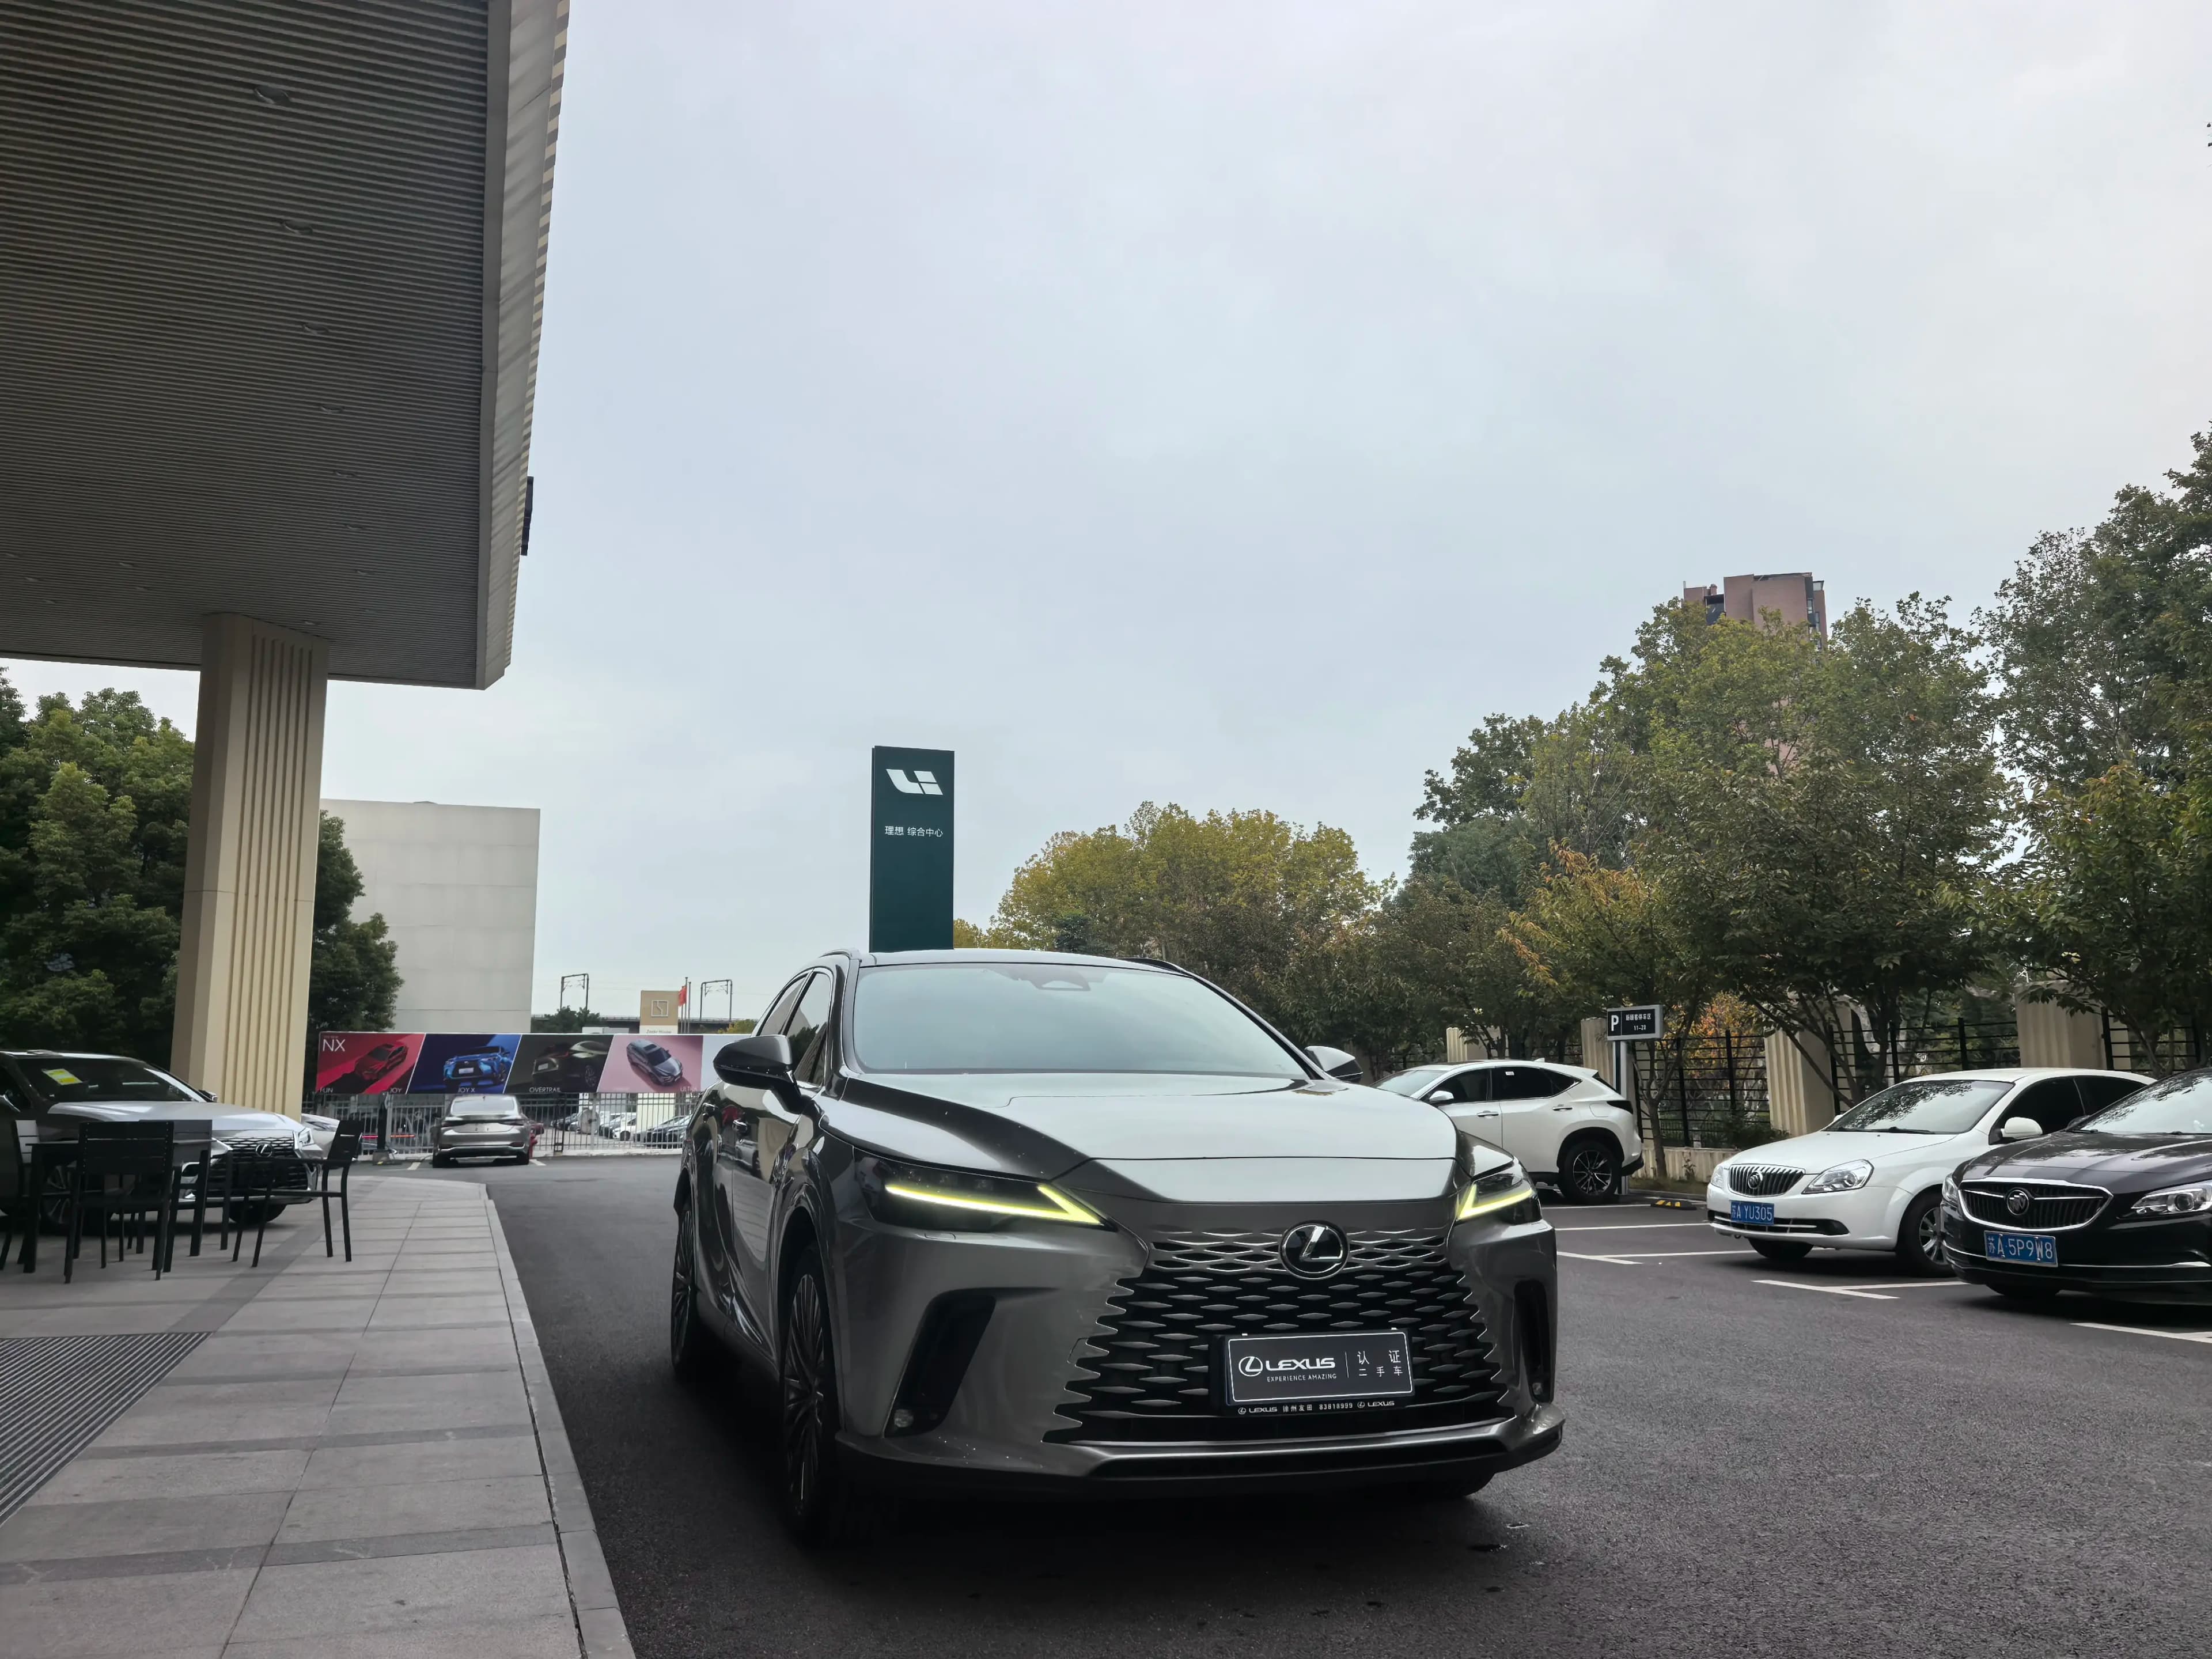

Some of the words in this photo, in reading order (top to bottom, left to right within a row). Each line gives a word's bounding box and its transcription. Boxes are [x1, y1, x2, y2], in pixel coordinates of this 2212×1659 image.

[885, 825, 904, 835] 理想
[907, 827, 943, 837] 综合中心
[1611, 1015, 1619, 1031] P
[323, 1039, 346, 1052] NX
[1266, 1357, 1336, 1371] LEXUS
[1267, 1374, 1306, 1382] EXPERIENCE
